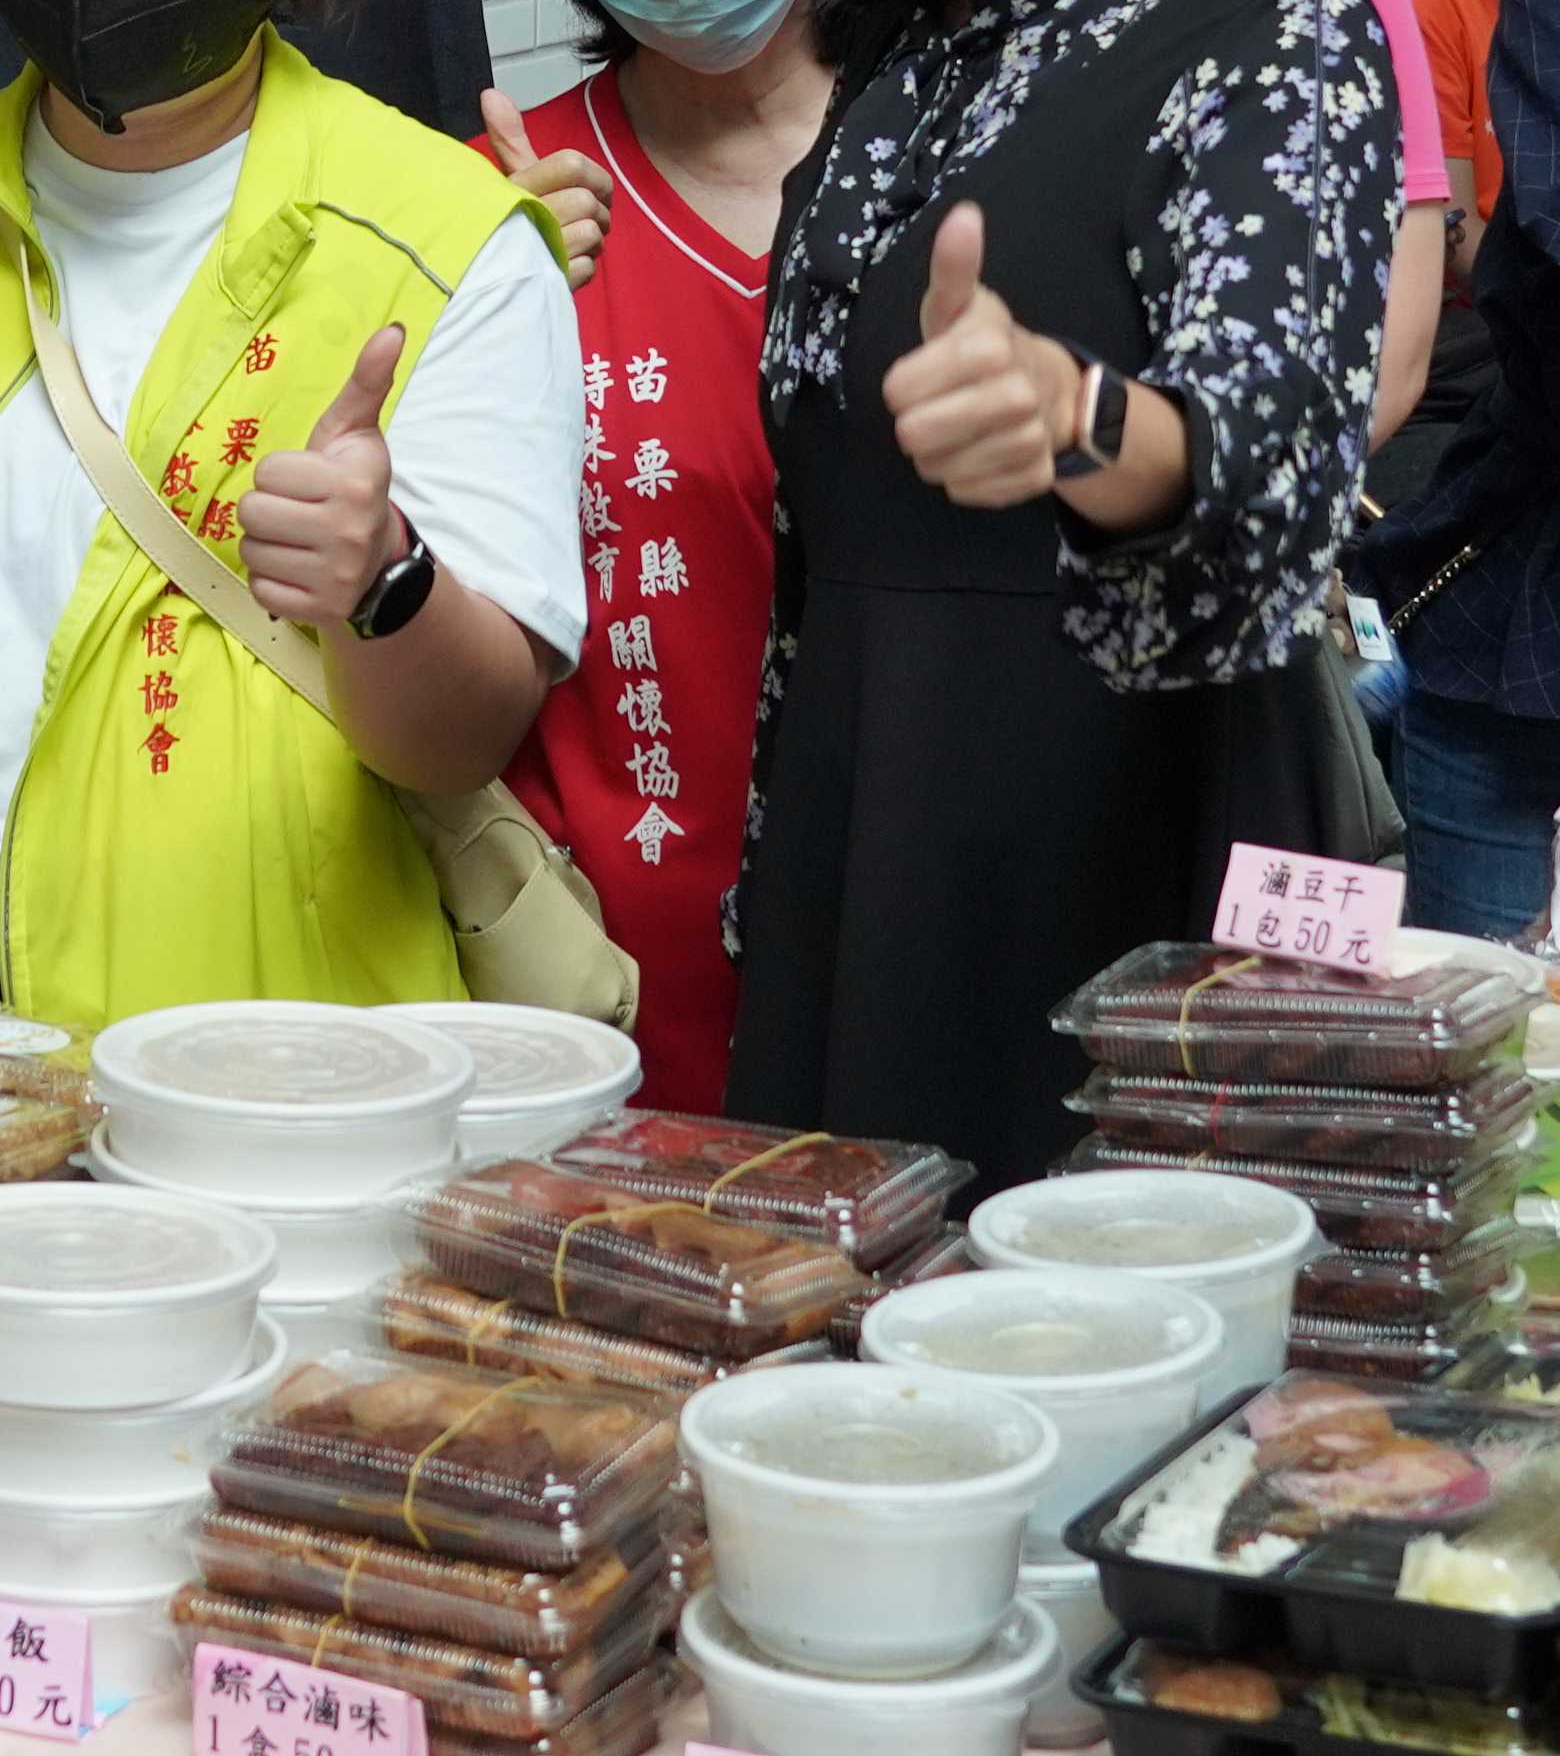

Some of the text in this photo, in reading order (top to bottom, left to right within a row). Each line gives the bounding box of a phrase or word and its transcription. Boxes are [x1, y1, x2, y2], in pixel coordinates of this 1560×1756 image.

[623, 346, 691, 600] 苗栗縣
[1259, 860, 1364, 913] 滷豆干
[209, 1659, 391, 1744] 綜合滷味
